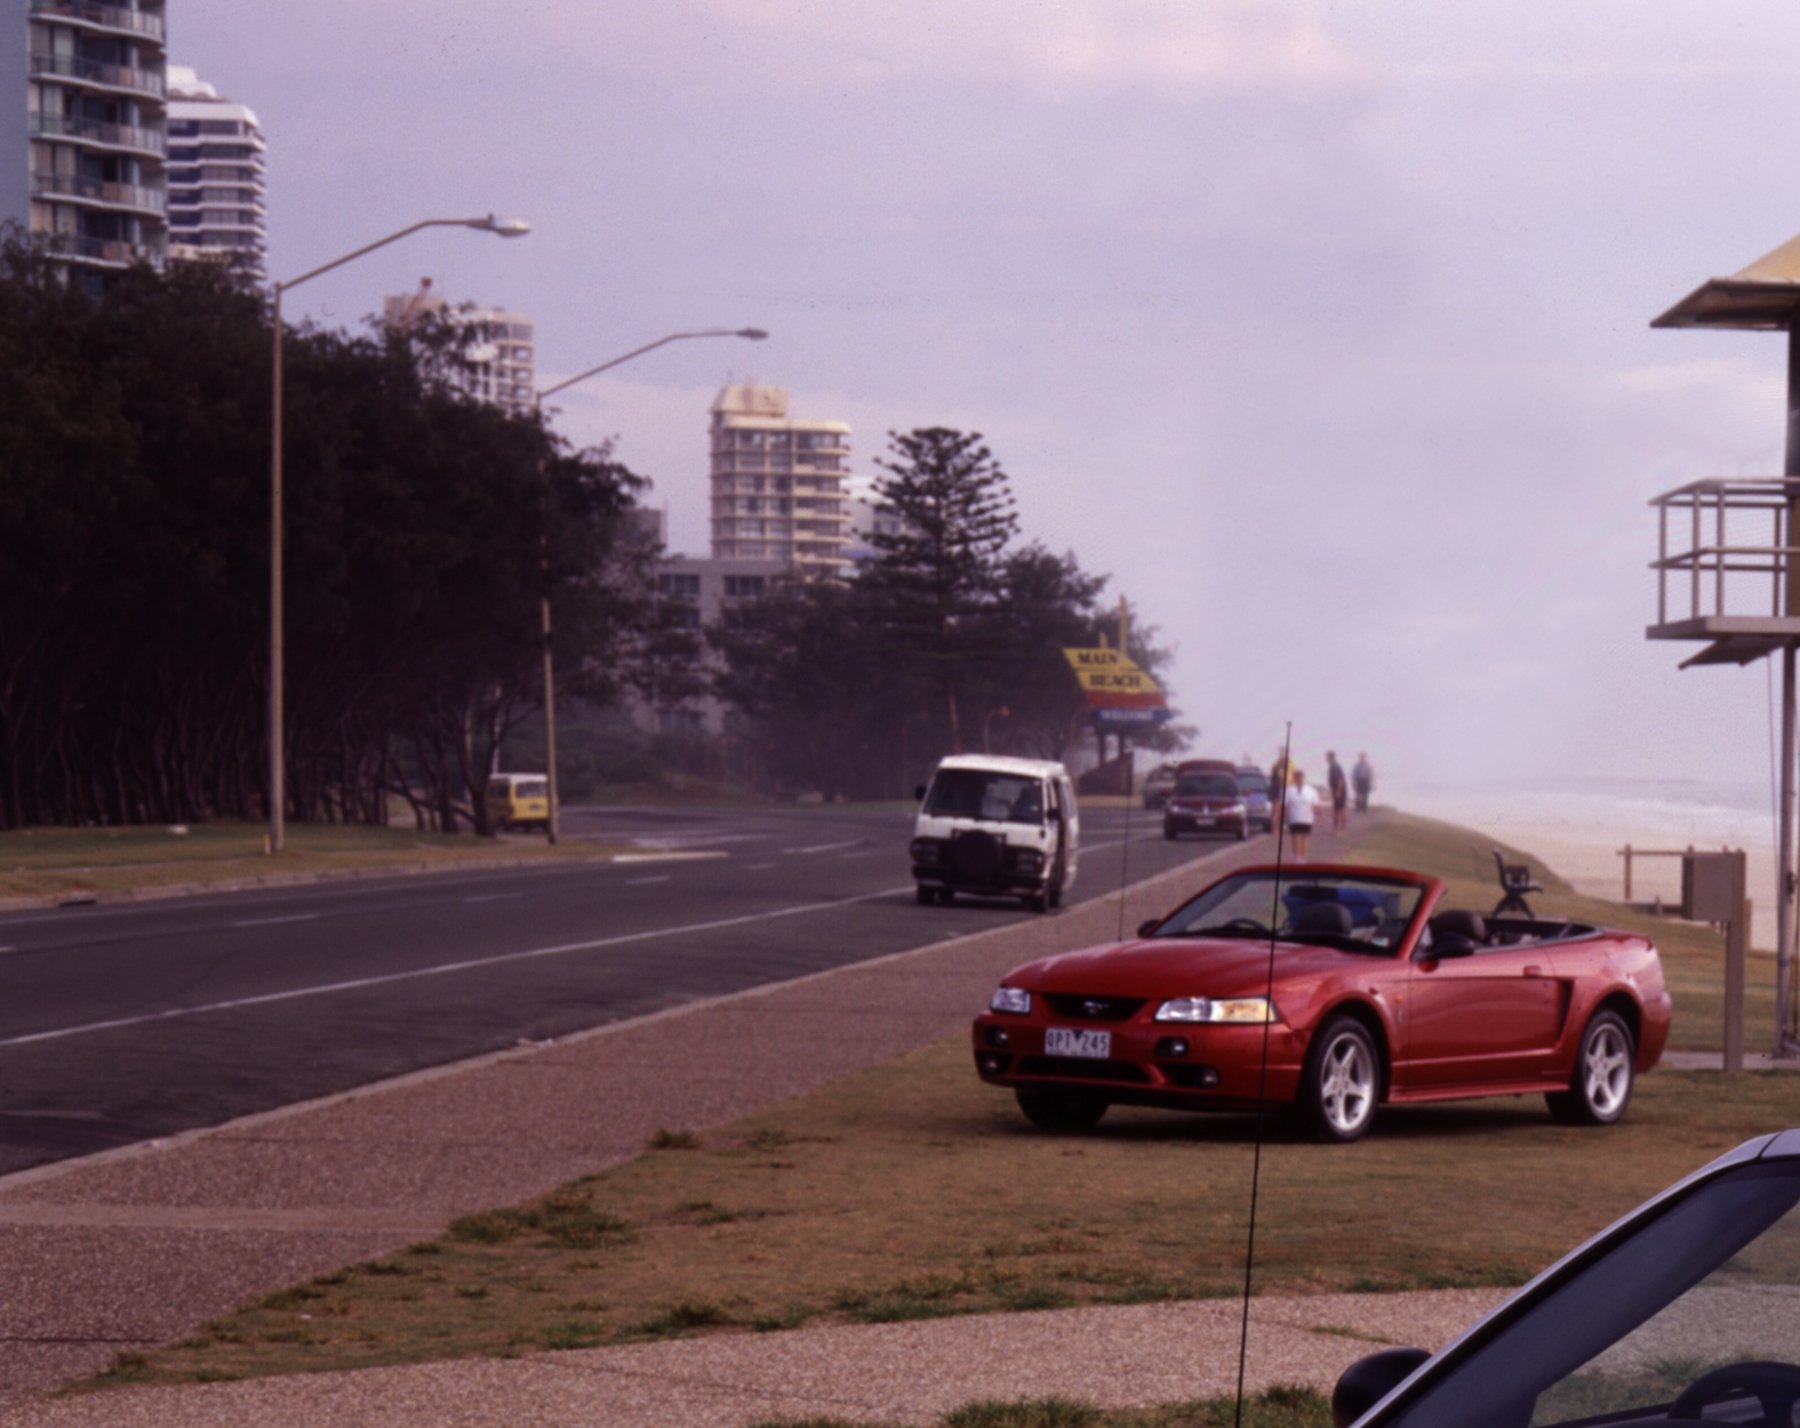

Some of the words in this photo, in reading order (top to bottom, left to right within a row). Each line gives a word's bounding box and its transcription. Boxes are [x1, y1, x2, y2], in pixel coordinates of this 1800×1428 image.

[1078, 652, 1118, 665] MAIN
[1089, 674, 1141, 687] BEACH
[1082, 1034, 1107, 1052] 245
